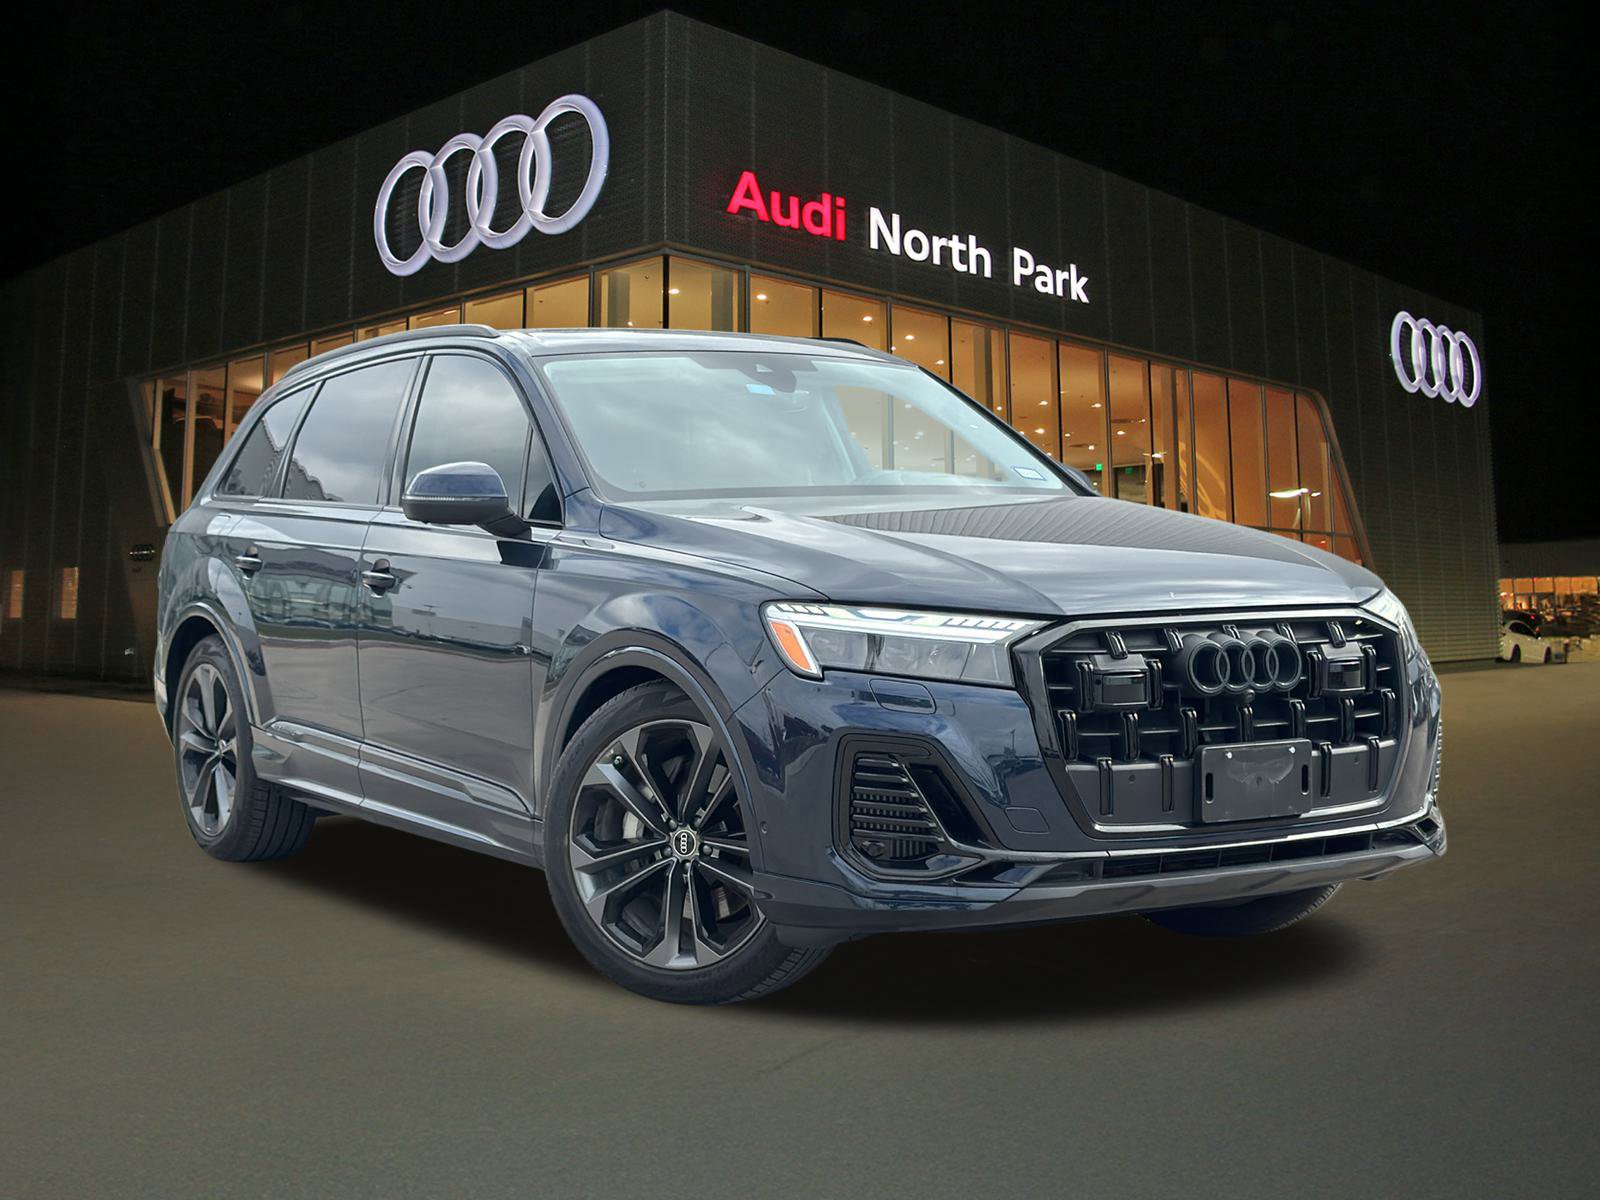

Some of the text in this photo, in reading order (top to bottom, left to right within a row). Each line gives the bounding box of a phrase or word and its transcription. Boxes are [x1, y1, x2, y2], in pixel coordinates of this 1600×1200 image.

[726, 171, 1090, 304] Audi North Park
